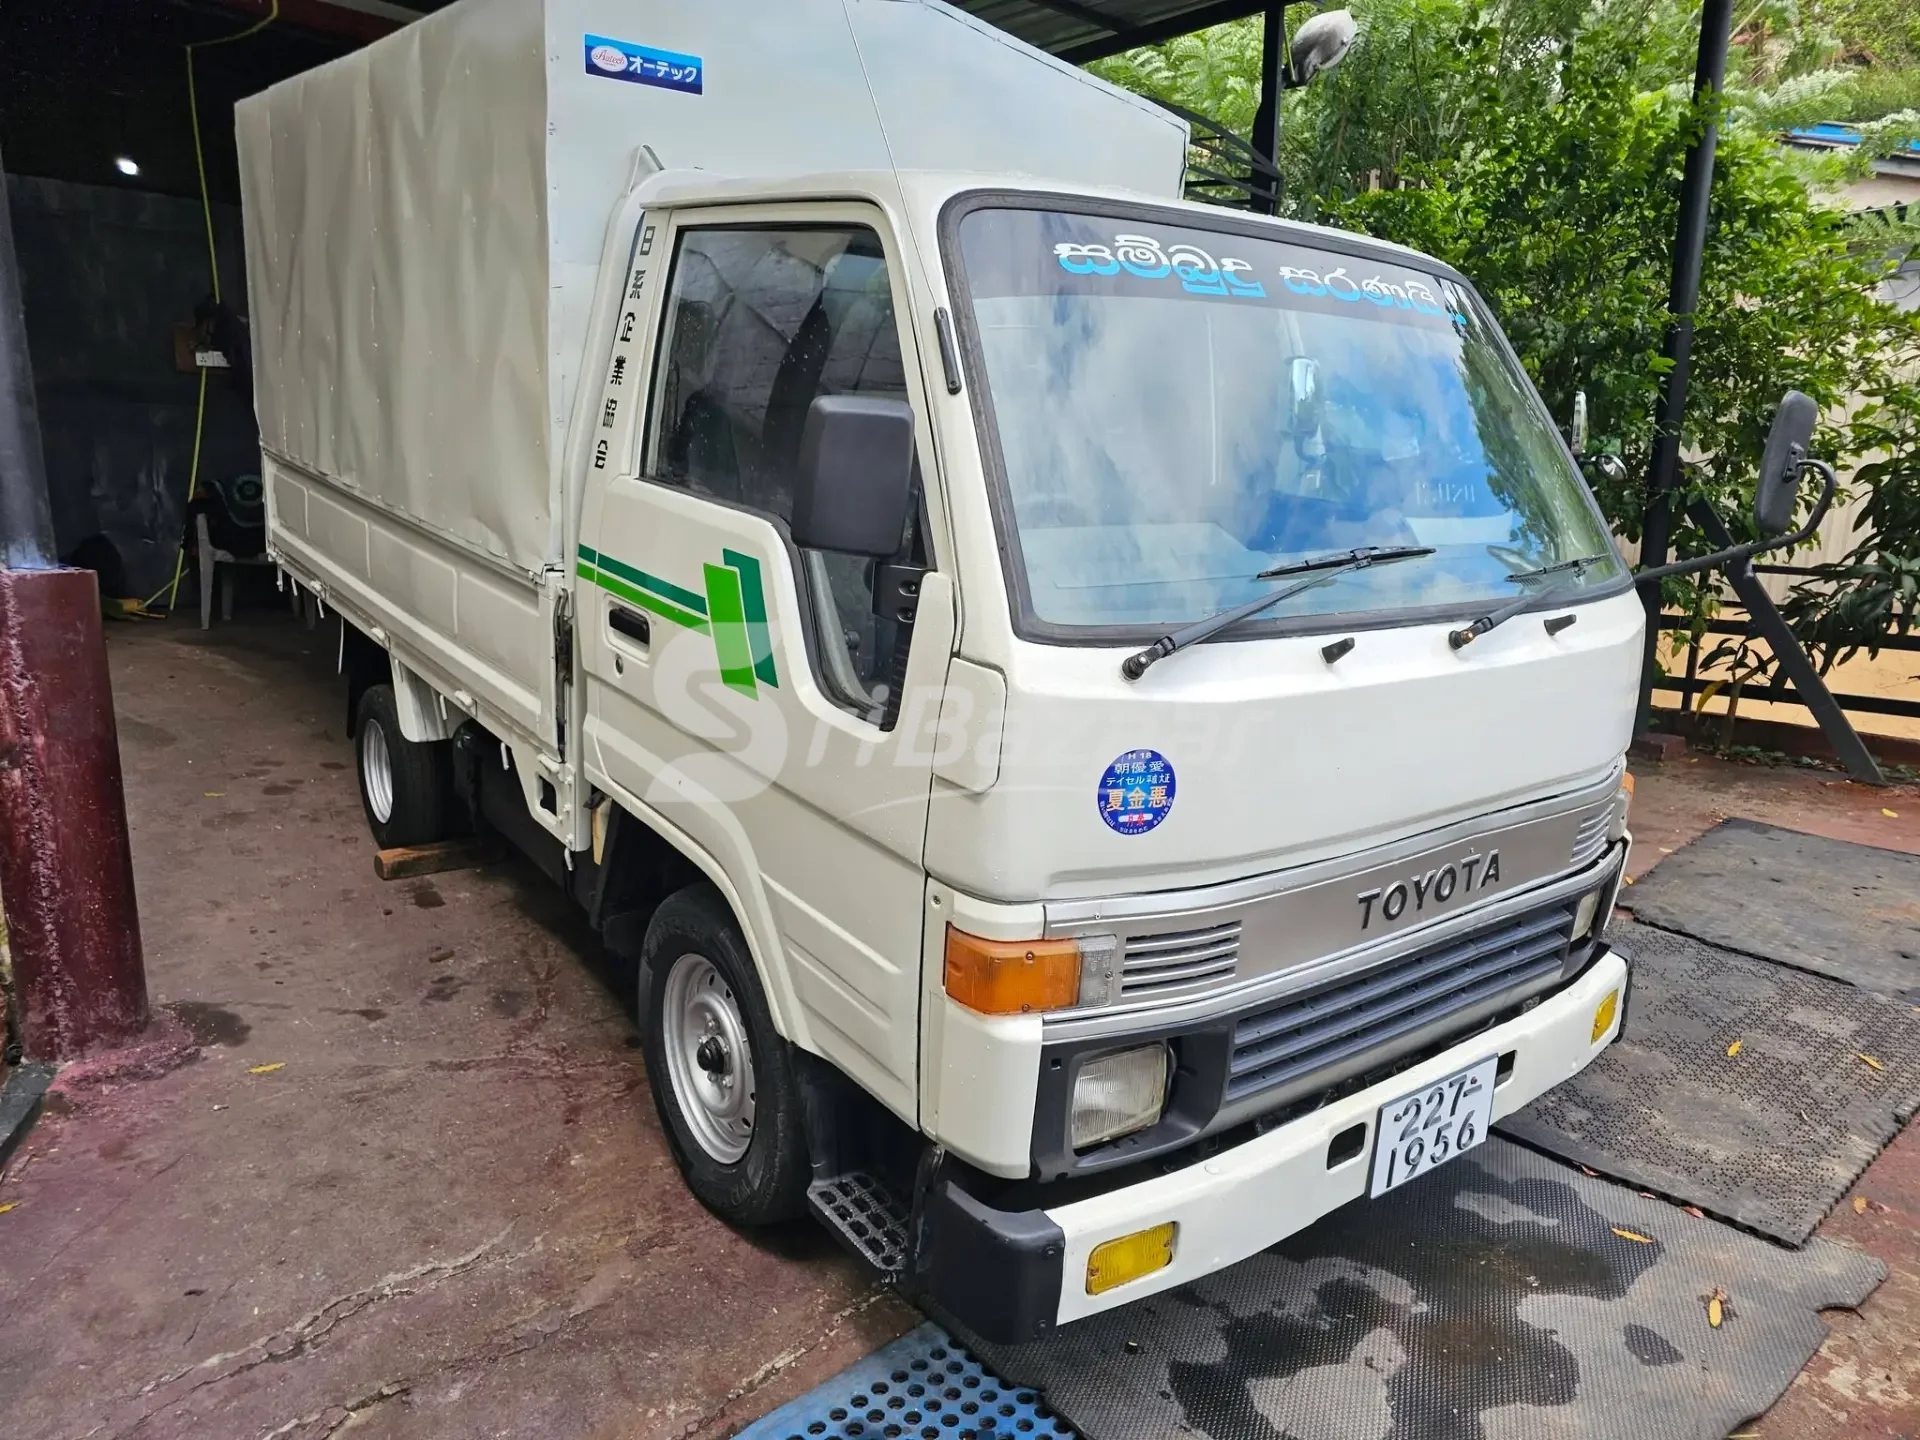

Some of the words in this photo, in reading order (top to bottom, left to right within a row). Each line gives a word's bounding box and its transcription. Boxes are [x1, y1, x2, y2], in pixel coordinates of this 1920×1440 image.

[629, 56, 697, 83] オーテック
[1053, 234, 1267, 298] සම්බුදු
[1357, 849, 1500, 930] TOYOTA
[1386, 1110, 1475, 1188] 1956
